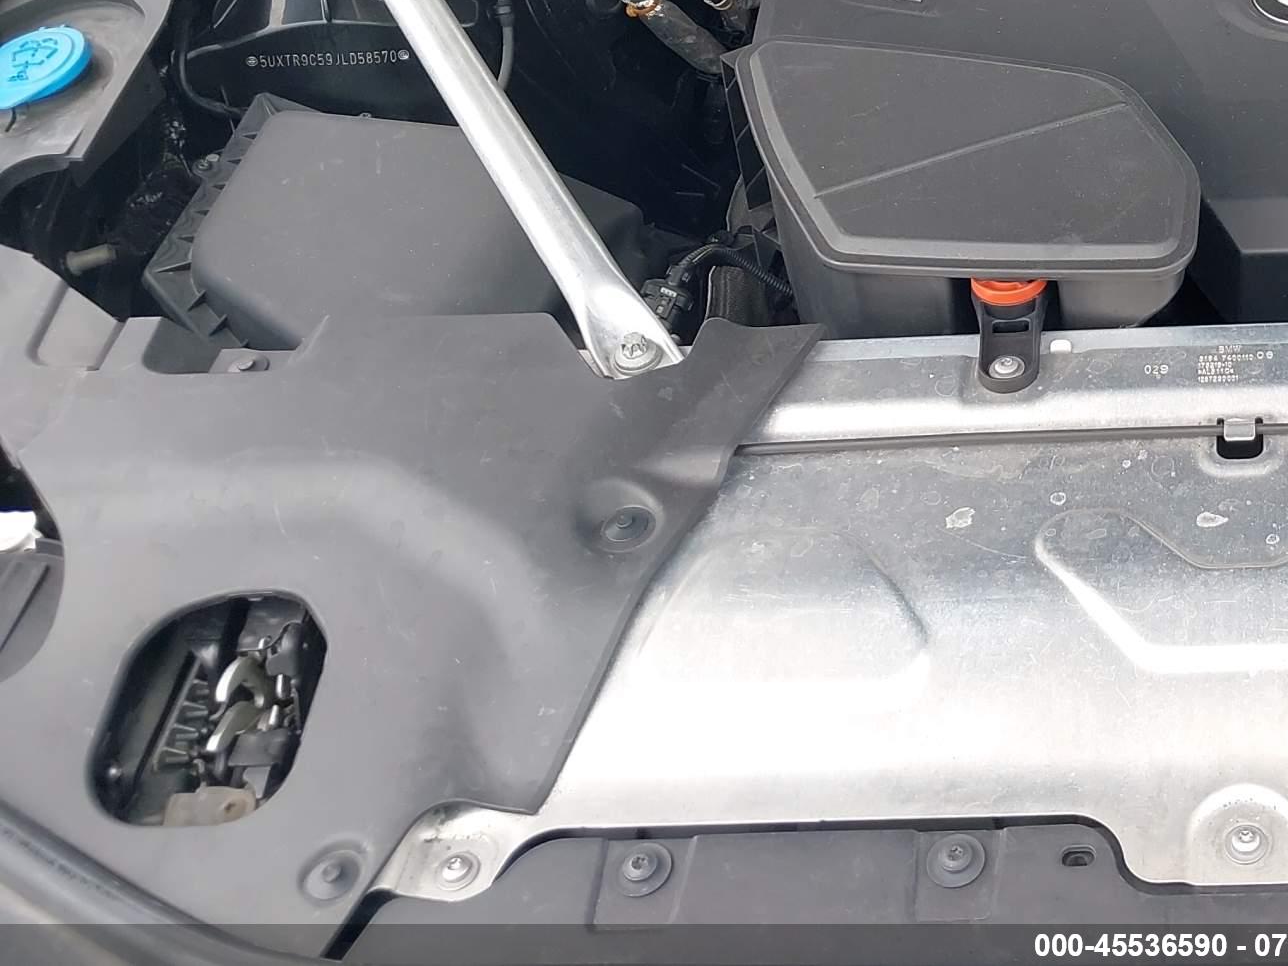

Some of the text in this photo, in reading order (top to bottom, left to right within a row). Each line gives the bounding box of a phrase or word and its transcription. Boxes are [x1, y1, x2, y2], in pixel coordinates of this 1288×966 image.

[258, 48, 398, 69] 5UXTR9C59JLD58570
[1218, 344, 1242, 354] BMW
[1144, 364, 1169, 376] 029
